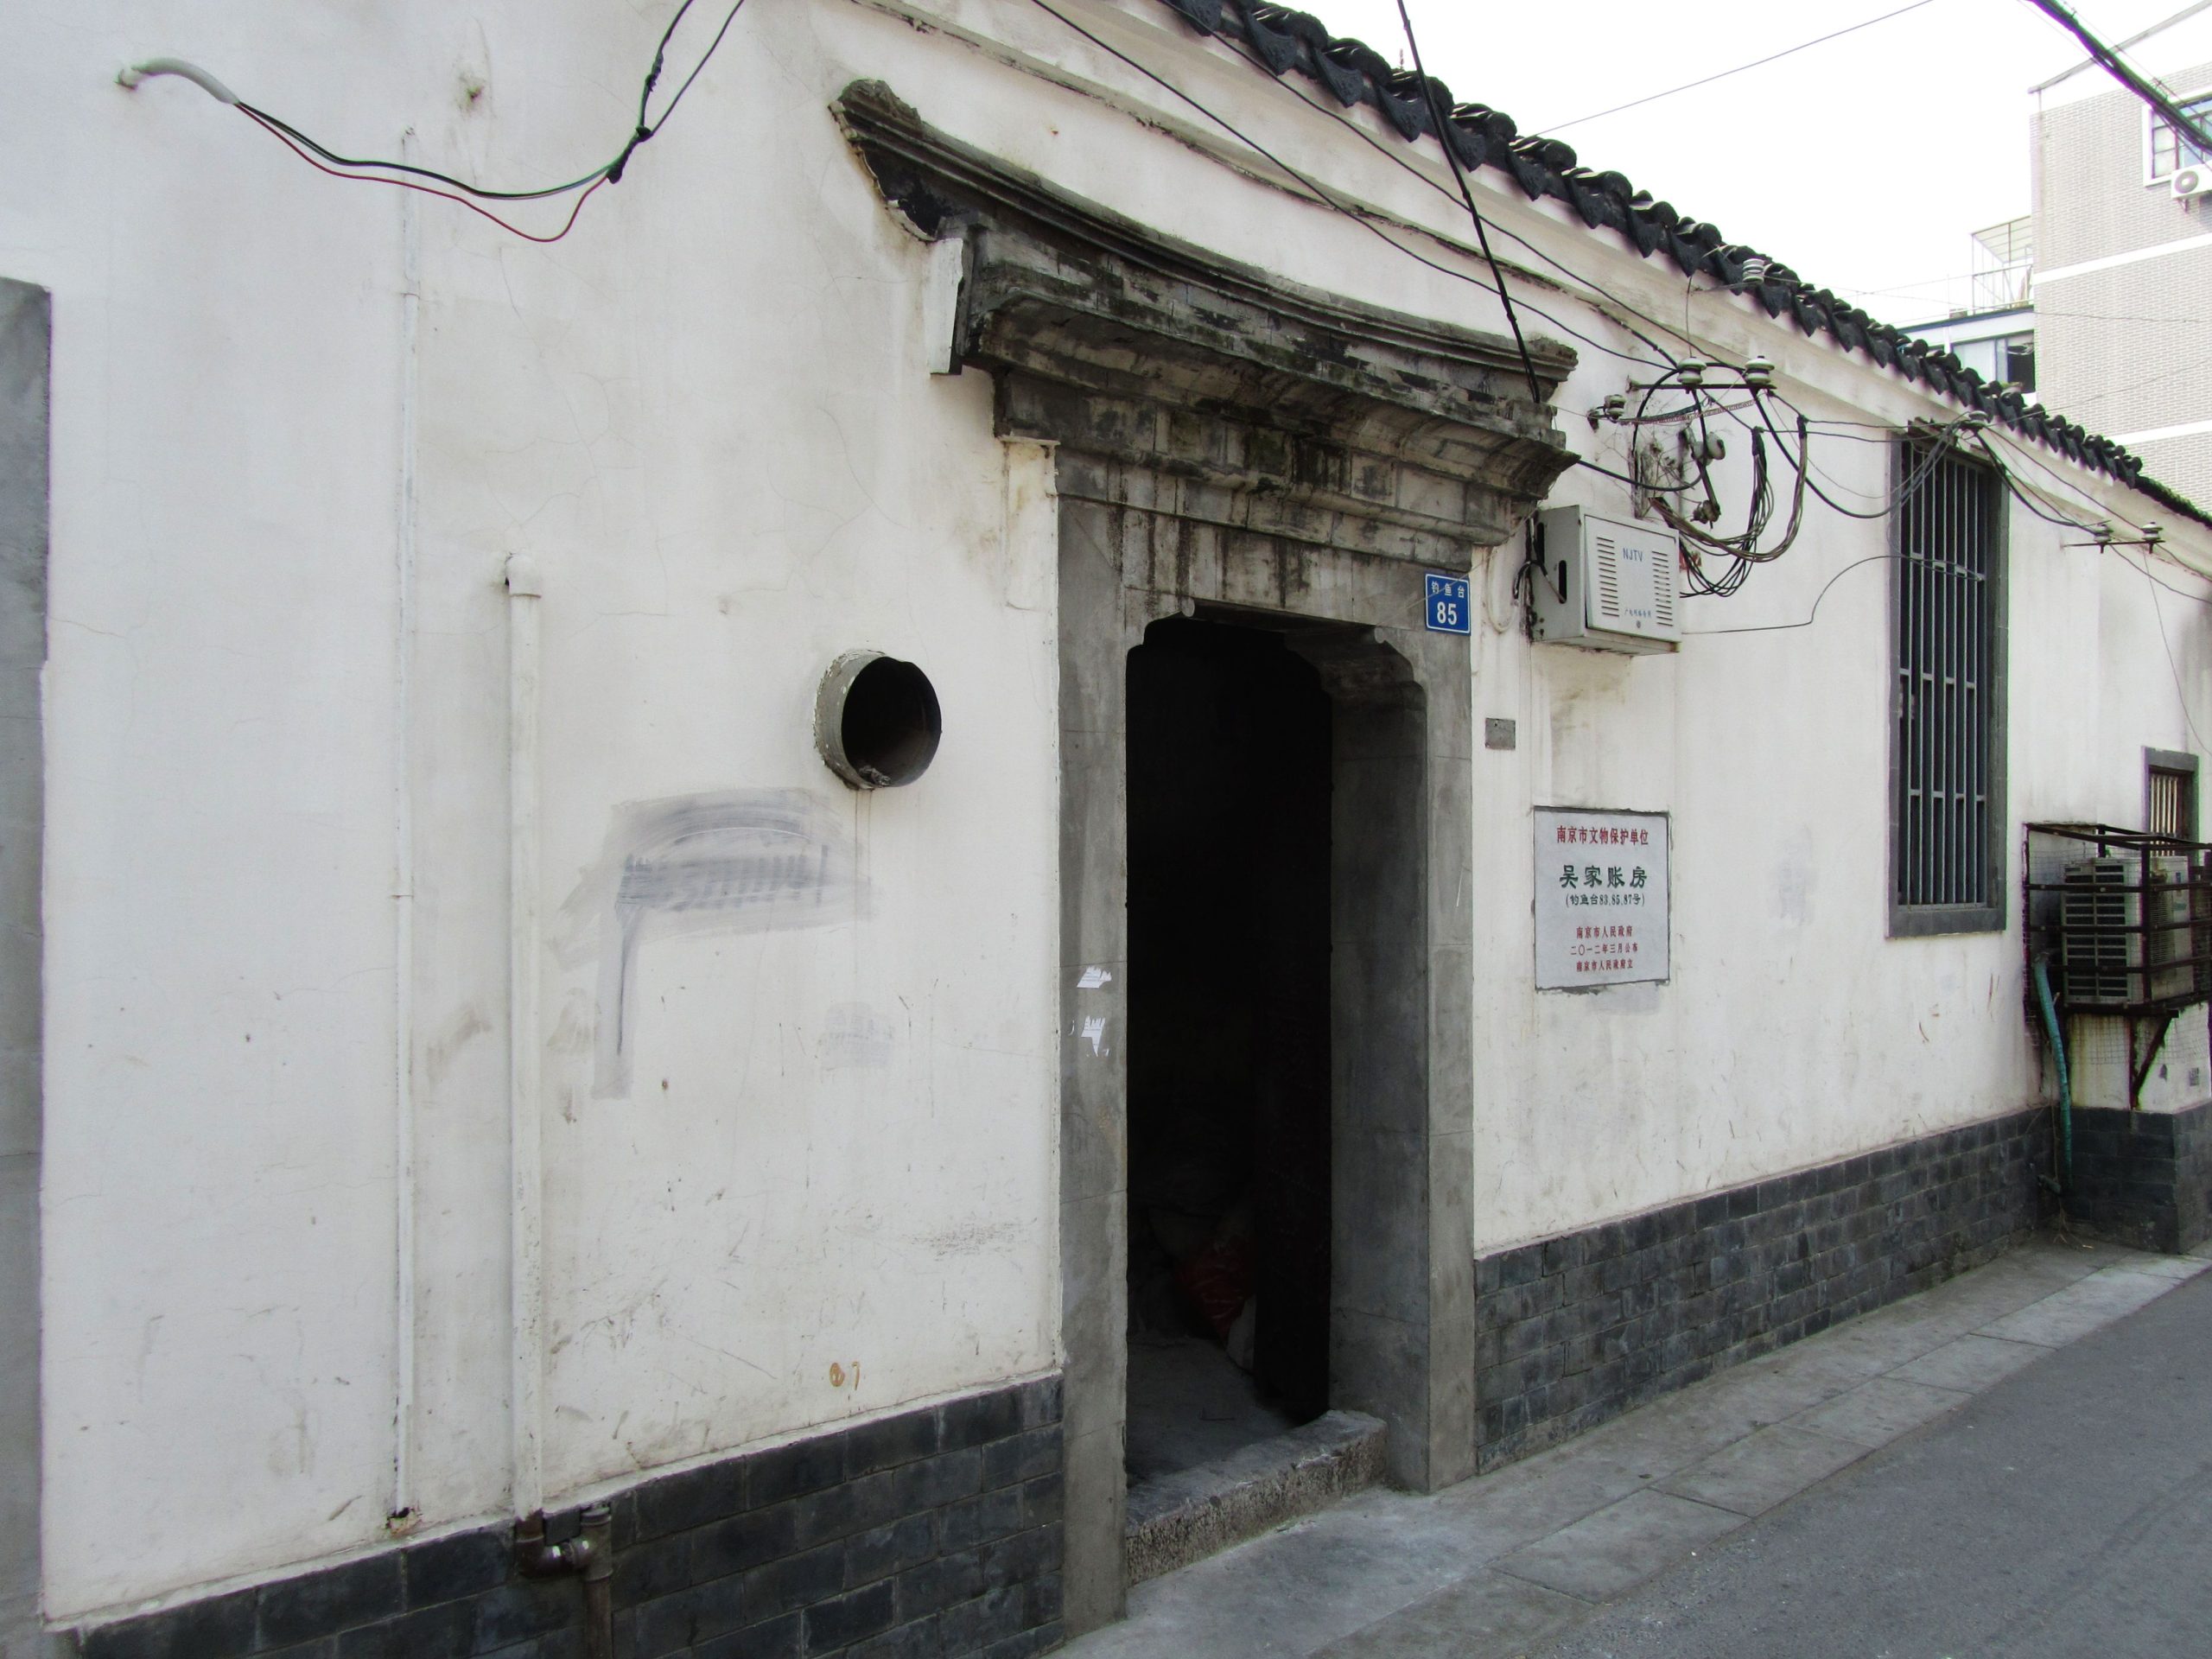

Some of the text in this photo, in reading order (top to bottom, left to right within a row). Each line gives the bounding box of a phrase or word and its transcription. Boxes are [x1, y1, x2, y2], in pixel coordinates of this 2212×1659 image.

[1623, 548, 1643, 562] NJTV
[1431, 581, 1465, 598] 钓鱼台
[1437, 601, 1458, 625] 85
[1556, 825, 1649, 845] 南京市文物保护单位
[1559, 865, 1647, 889] 吴家账房
[1576, 925, 1632, 939] 南京市人民政府
[1576, 958, 1633, 972] 南京市人民政府立
